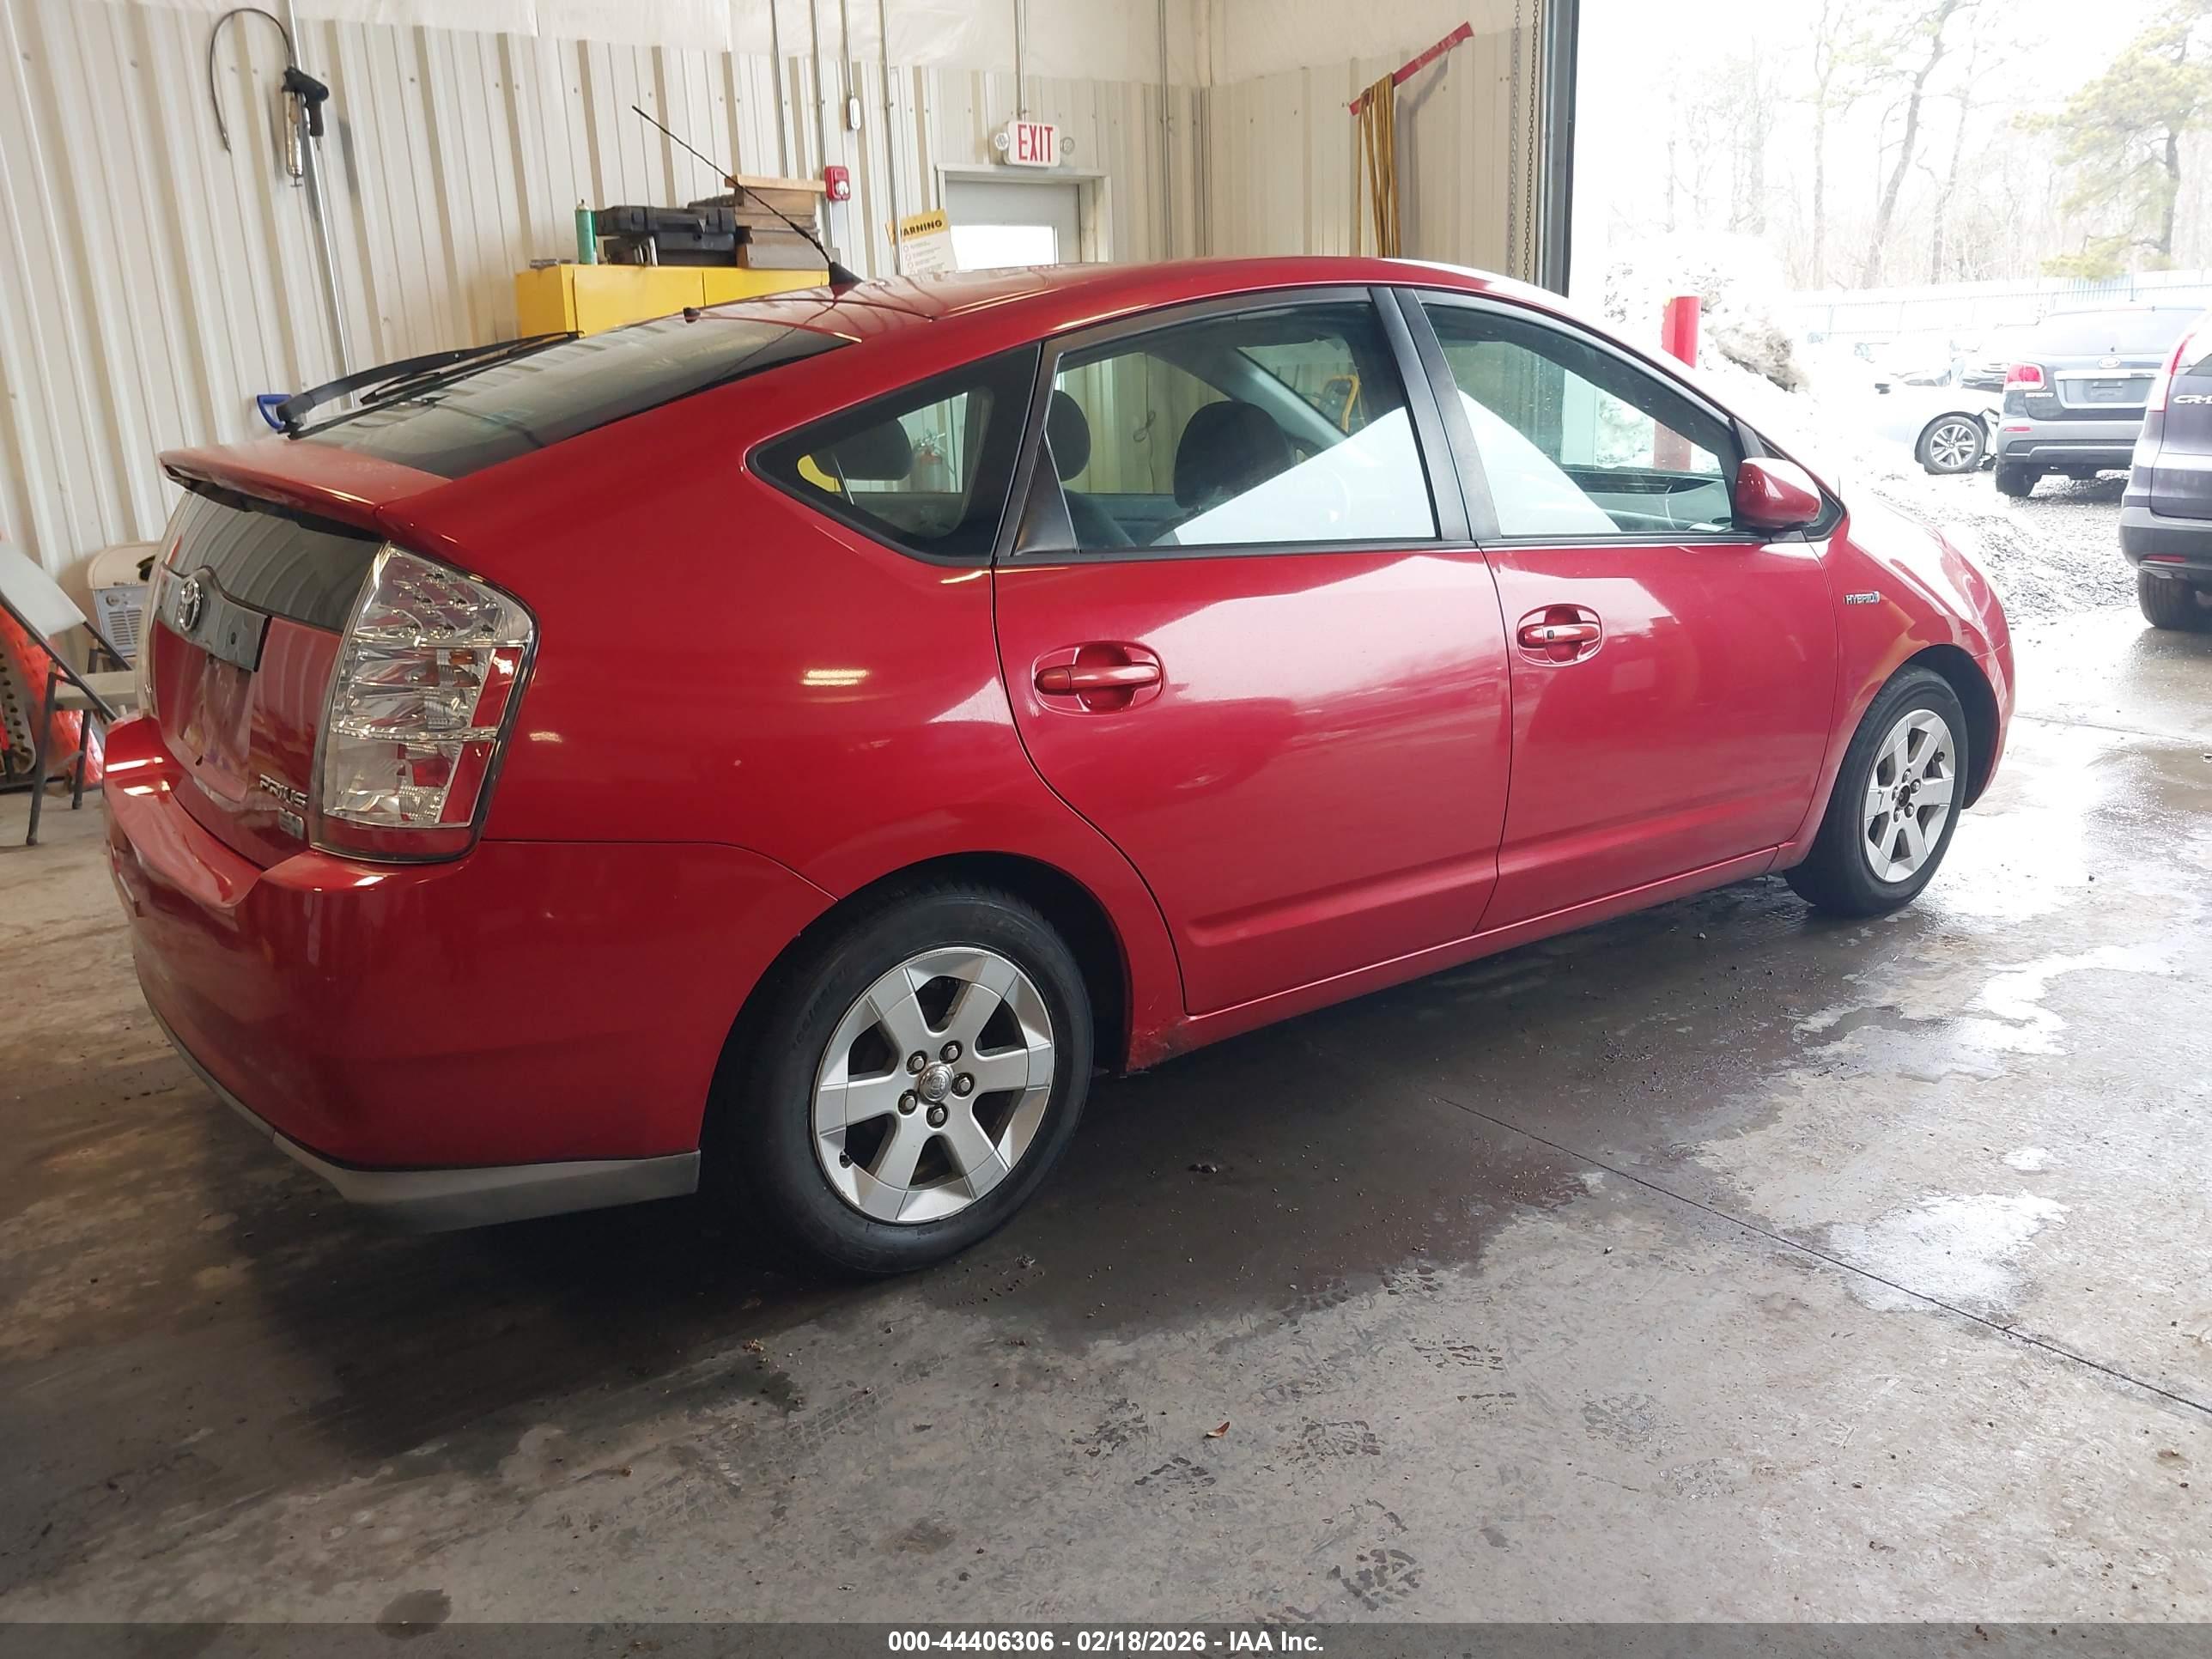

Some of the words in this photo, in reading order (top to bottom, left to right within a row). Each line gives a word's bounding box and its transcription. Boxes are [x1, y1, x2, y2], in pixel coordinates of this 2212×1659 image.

[1018, 124, 1054, 162] EXIT
[900, 219, 943, 238] ARNING
[1844, 591, 1880, 605] HYBRID
[260, 774, 308, 808] PRIUS
